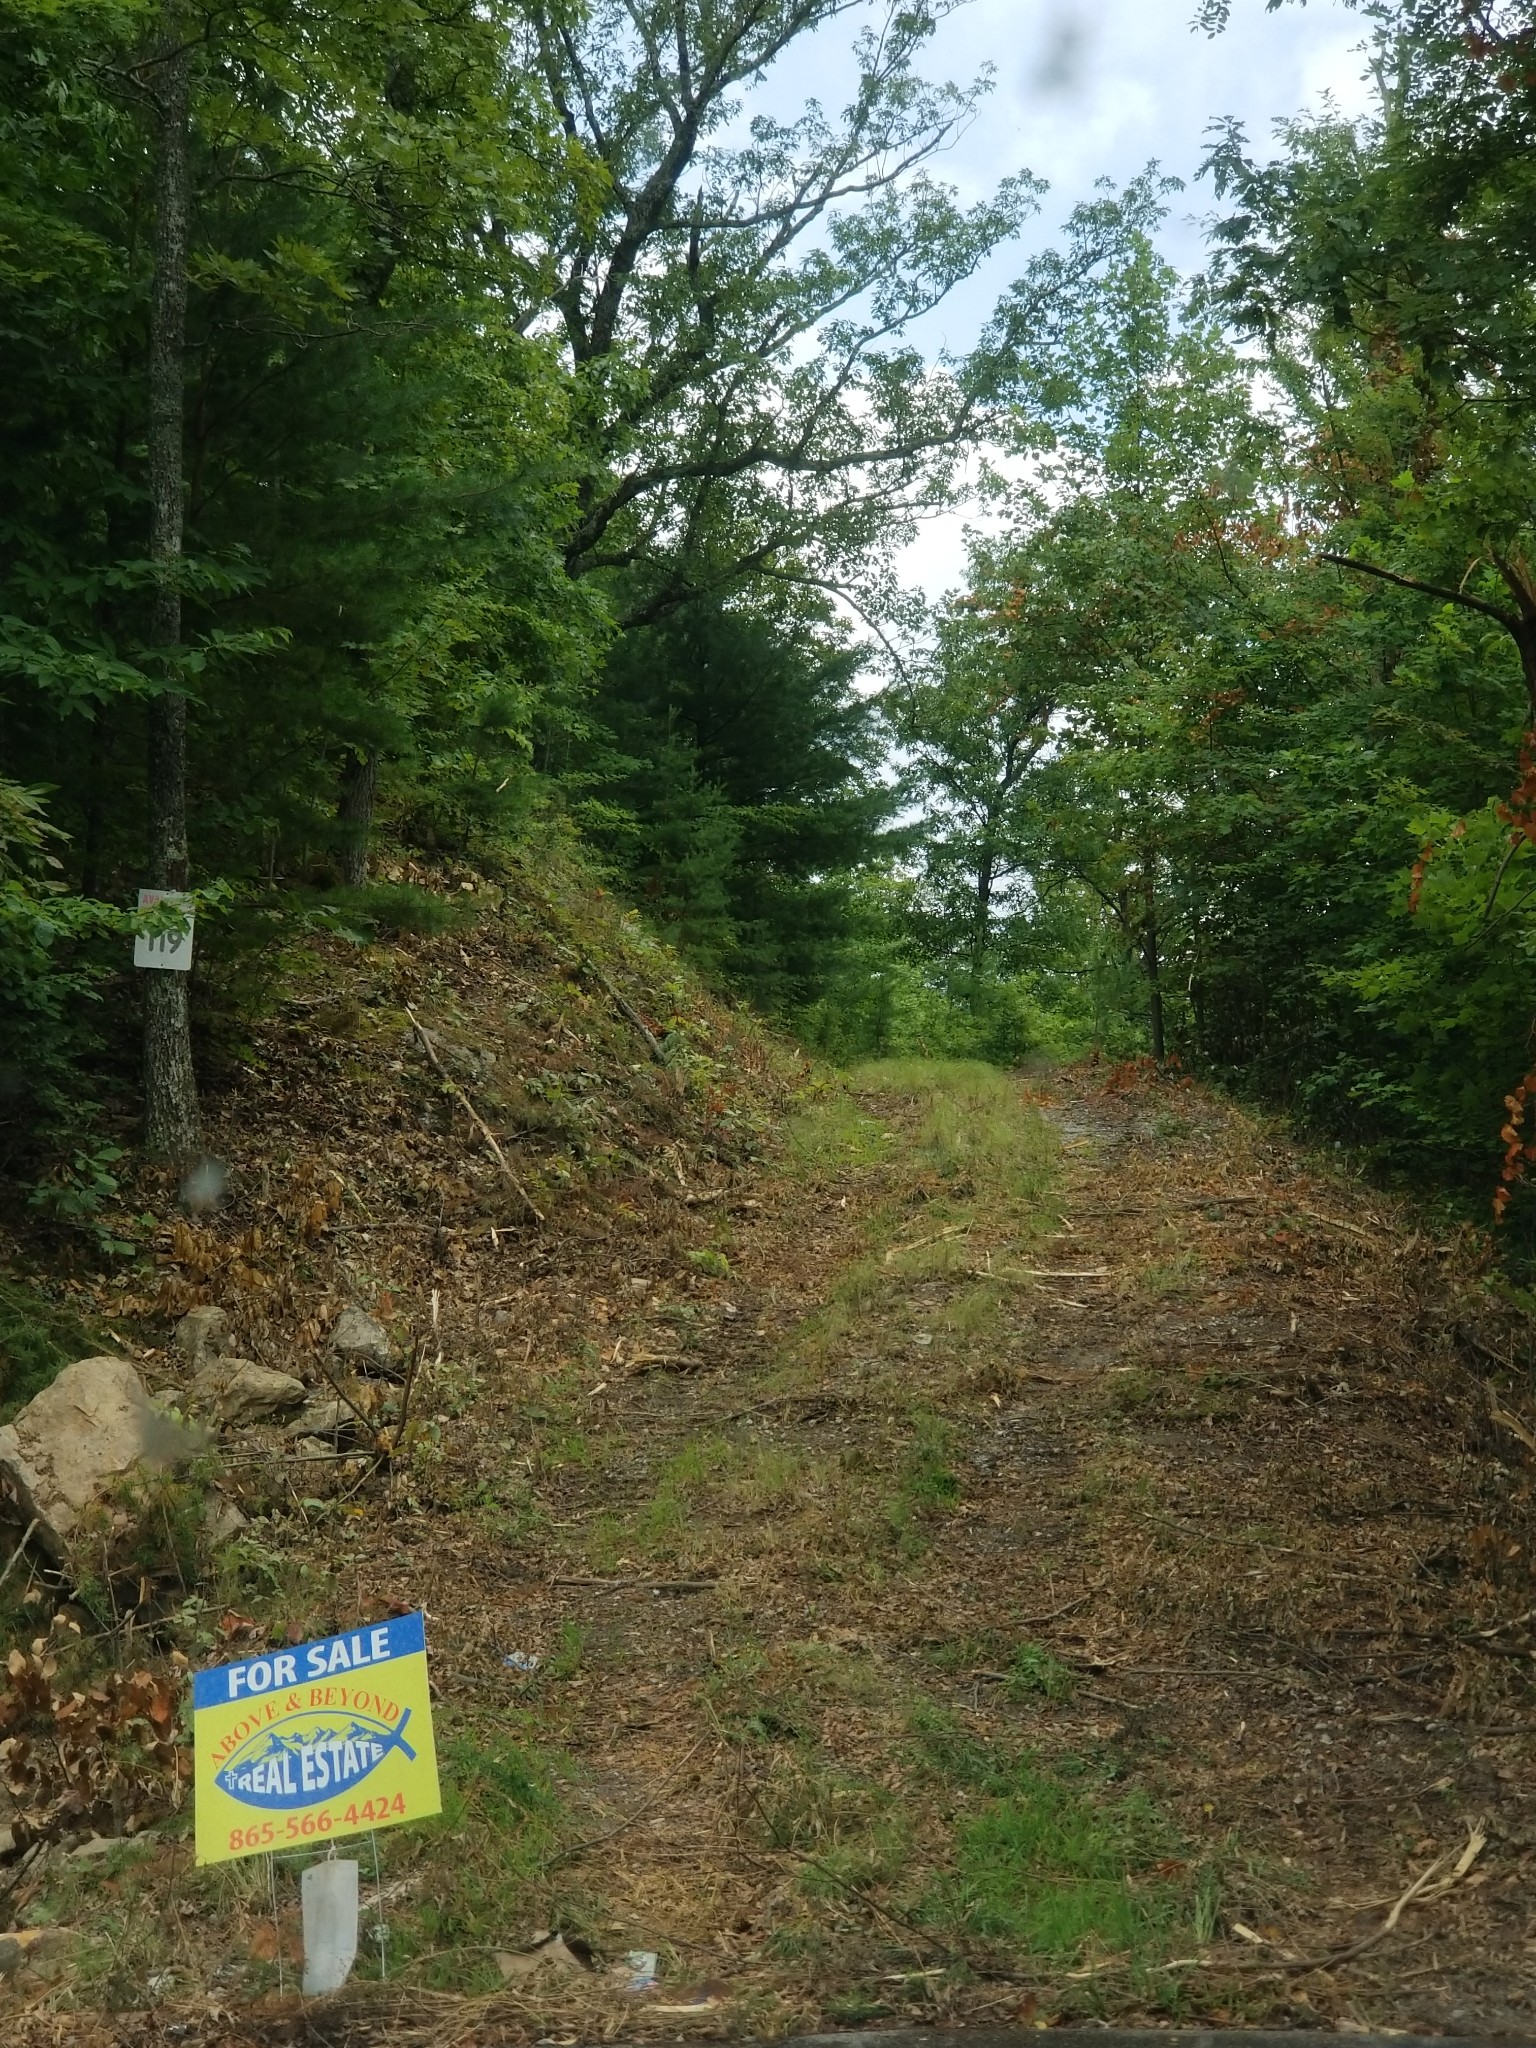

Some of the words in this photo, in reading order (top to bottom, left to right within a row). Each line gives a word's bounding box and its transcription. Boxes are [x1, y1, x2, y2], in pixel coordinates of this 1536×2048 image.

[148, 929, 182, 954] 119
[228, 1654, 297, 1698] FOR
[307, 1627, 391, 1677] SALE
[211, 1700, 281, 1770] ABOVE
[285, 1692, 302, 1713] &
[309, 1687, 400, 1723] BEYOND
[237, 1753, 297, 1795] REAL
[302, 1740, 384, 1792] ESTATE
[228, 1792, 406, 1851] 865-566-4424
